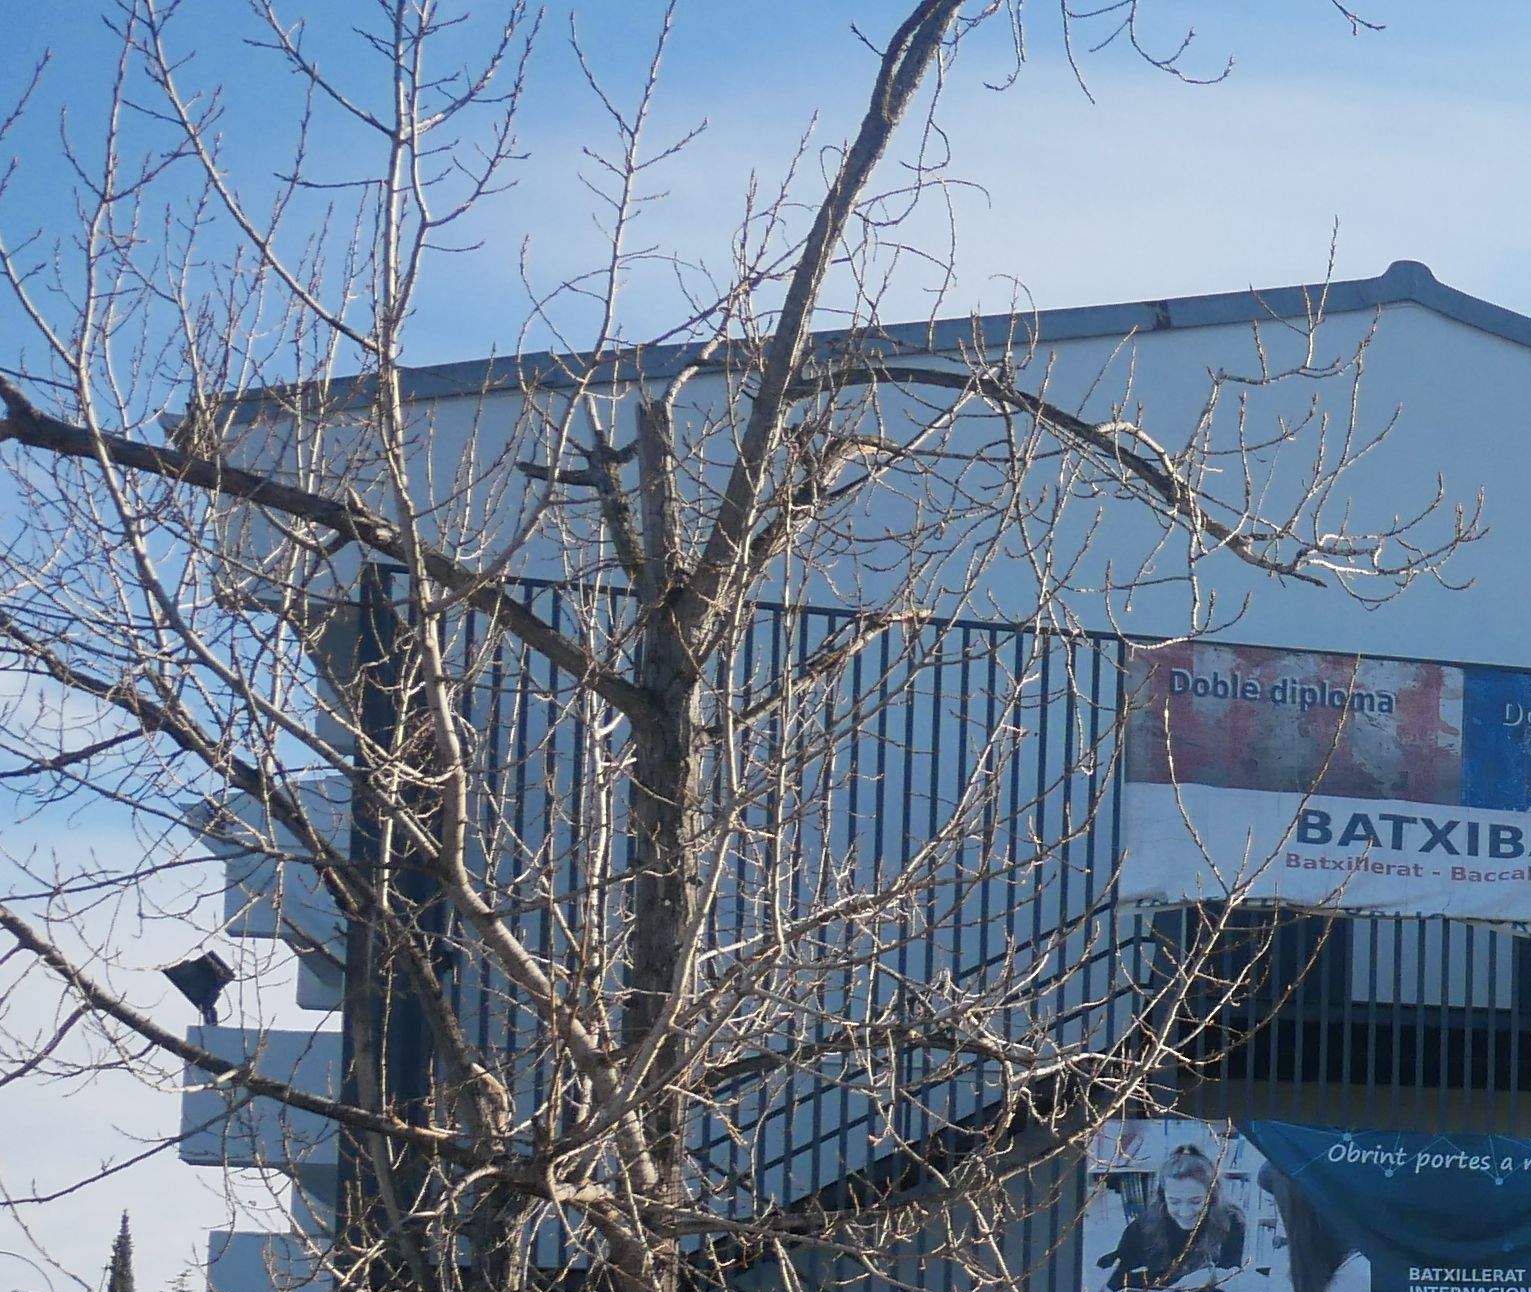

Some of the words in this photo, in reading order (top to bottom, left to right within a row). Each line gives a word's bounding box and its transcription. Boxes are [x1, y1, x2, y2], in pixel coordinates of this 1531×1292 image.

[1168, 667, 1262, 701] Doble
[1270, 677, 1398, 714] diploma
[1285, 852, 1423, 878] Batxillerat
[1327, 1142, 1406, 1167] Obrint
[1414, 1148, 1491, 1174] portes
[1500, 1156, 1513, 1172] a
[1408, 1267, 1526, 1283] BATXILLERAT
